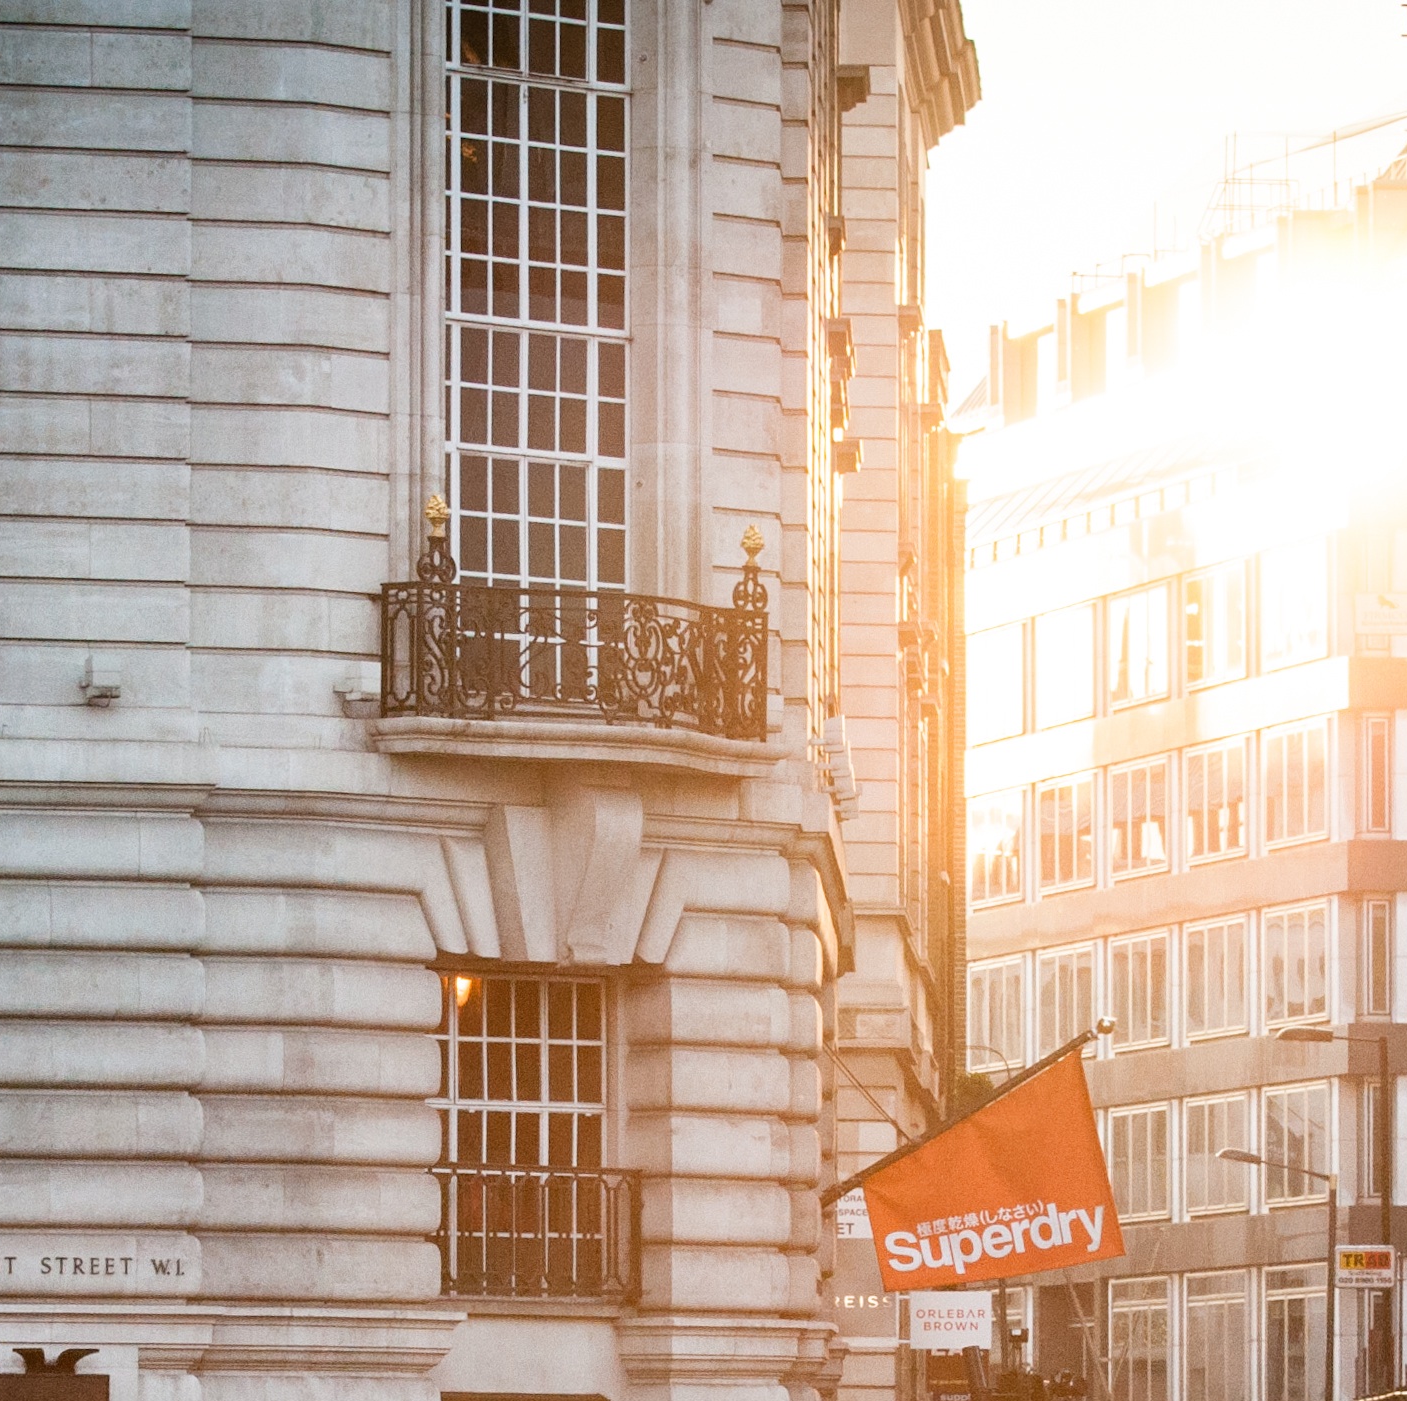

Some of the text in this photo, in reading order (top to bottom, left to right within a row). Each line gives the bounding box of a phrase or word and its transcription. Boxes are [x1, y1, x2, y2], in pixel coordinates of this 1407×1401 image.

[884, 1202, 1104, 1275] Superdry
[40, 1257, 133, 1276] STREET
[915, 1308, 986, 1319] ORLEBAR
[923, 1321, 979, 1332] BROWN
